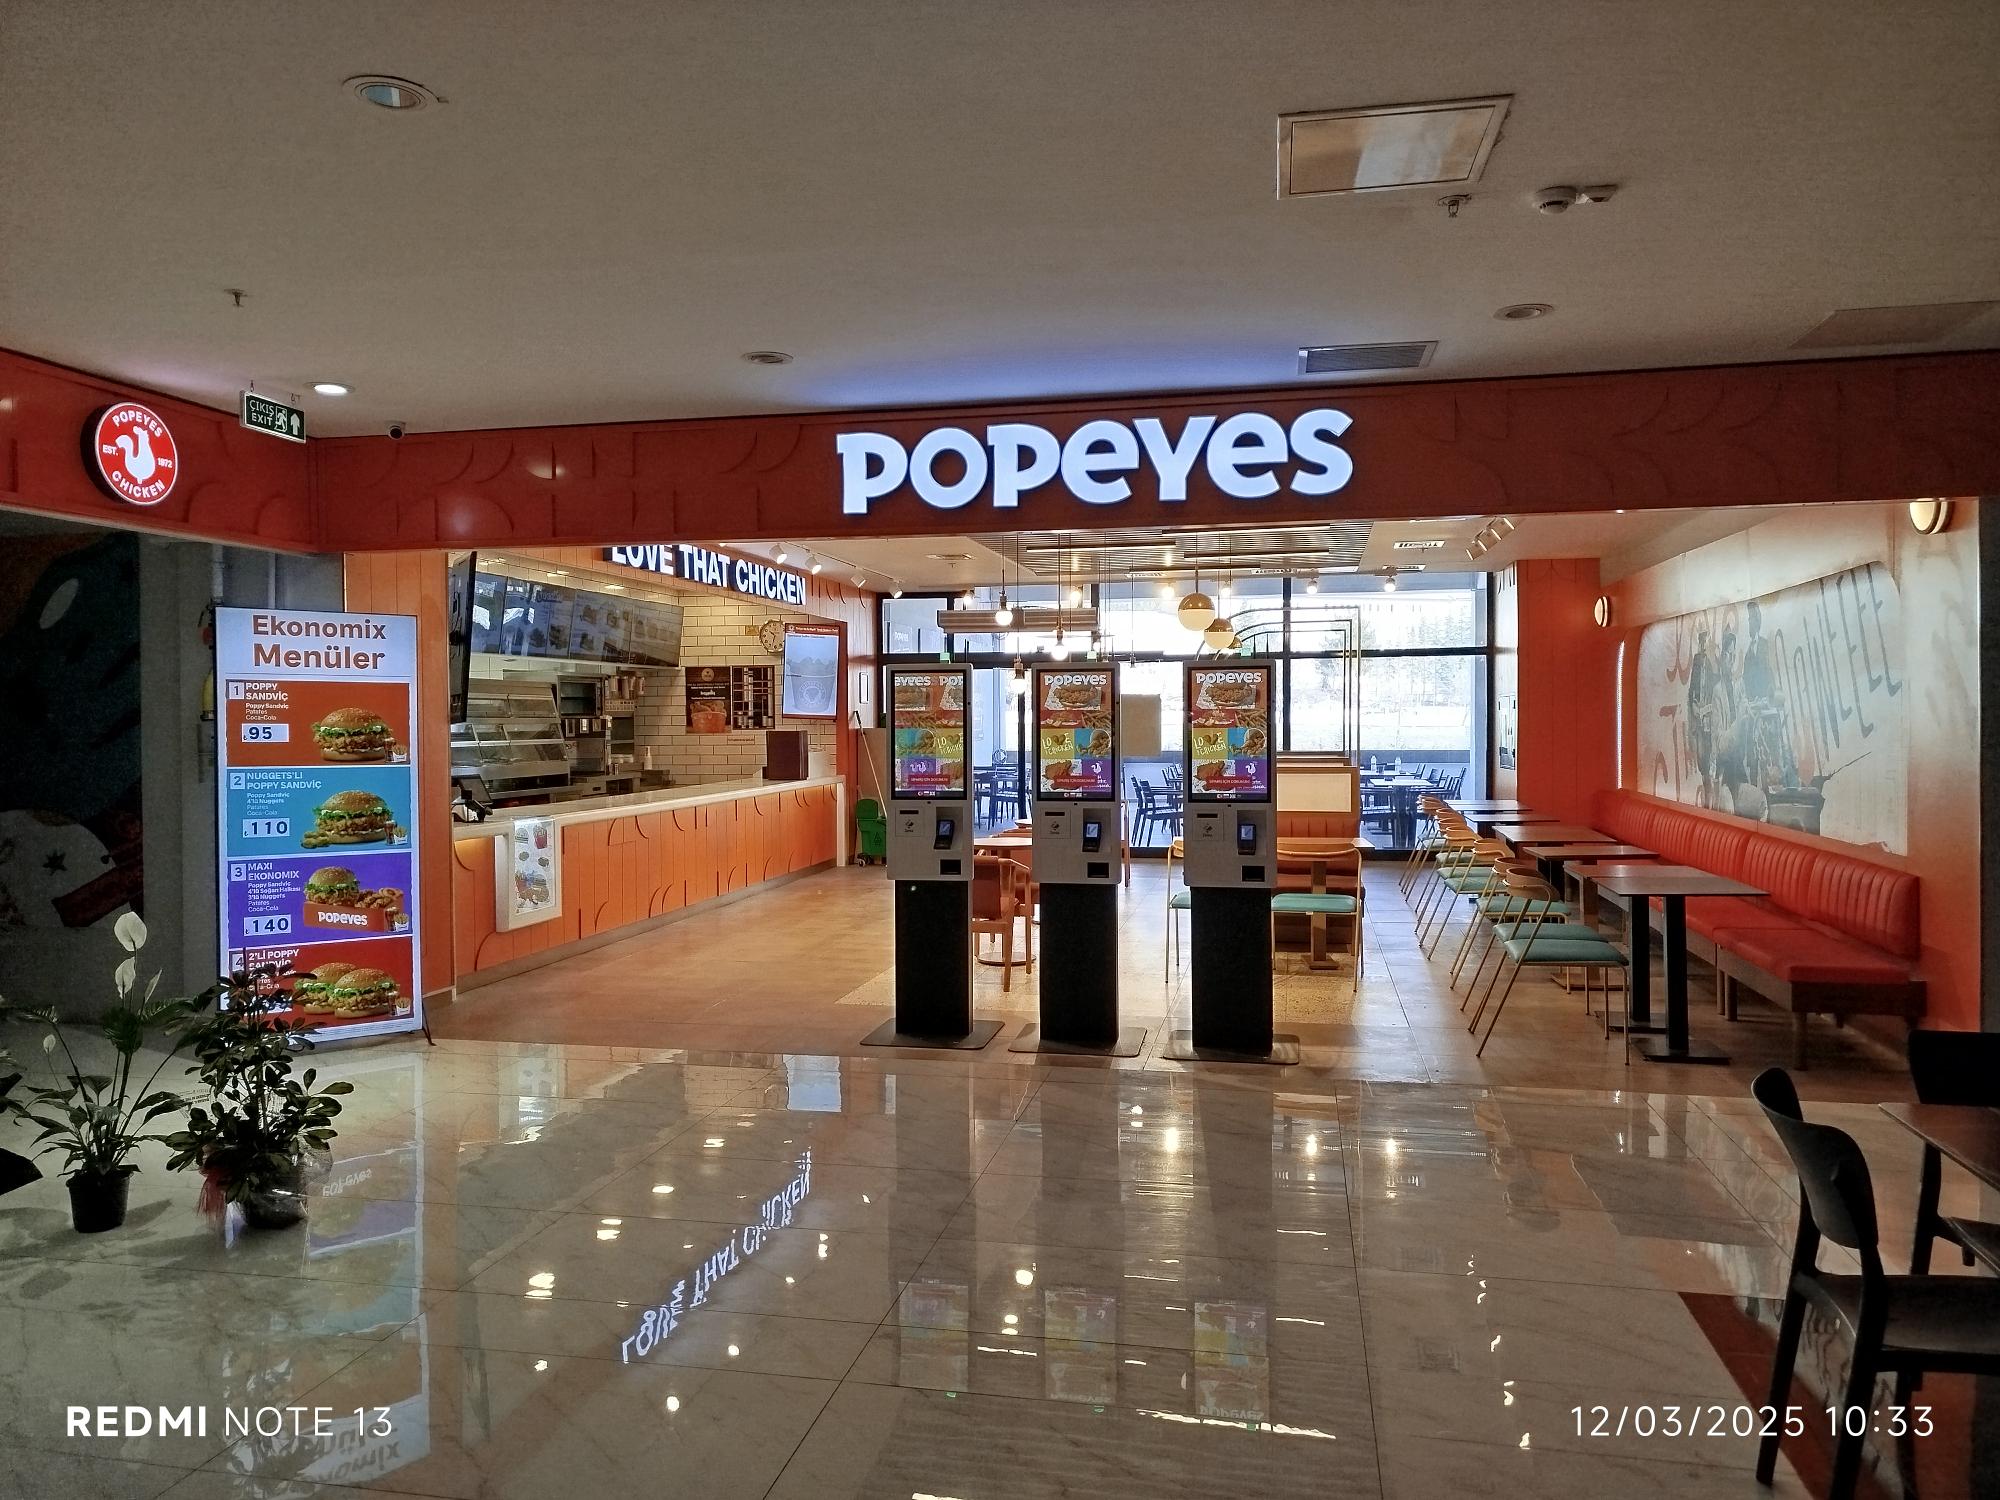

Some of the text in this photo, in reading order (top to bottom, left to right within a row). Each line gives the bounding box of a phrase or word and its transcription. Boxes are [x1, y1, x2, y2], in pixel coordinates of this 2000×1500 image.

[250, 400, 274, 417] ÇIKIŞ
[112, 410, 163, 437] POPEYES
[252, 412, 273, 426] EXIT
[102, 444, 119, 456] EST.
[158, 457, 173, 469] 1972
[112, 470, 165, 498] CHICKEN
[612, 543, 807, 606] LOVE THAT CHICKEN
[252, 614, 387, 639] Ekonomix
[253, 643, 386, 670] Menüler
[233, 685, 240, 696] 1
[245, 682, 278, 691] POPPY
[245, 690, 289, 702] SANDVİÇ
[245, 702, 265, 710] Poppy
[233, 775, 242, 786] 2
[247, 779, 322, 790] POPPY SANDVİÇ
[247, 862, 273, 871] MAXI
[234, 867, 243, 878] 3
[248, 870, 300, 881] EKONOMIX
[267, 948, 300, 959] POPPY
[235, 956, 243, 967] 4
